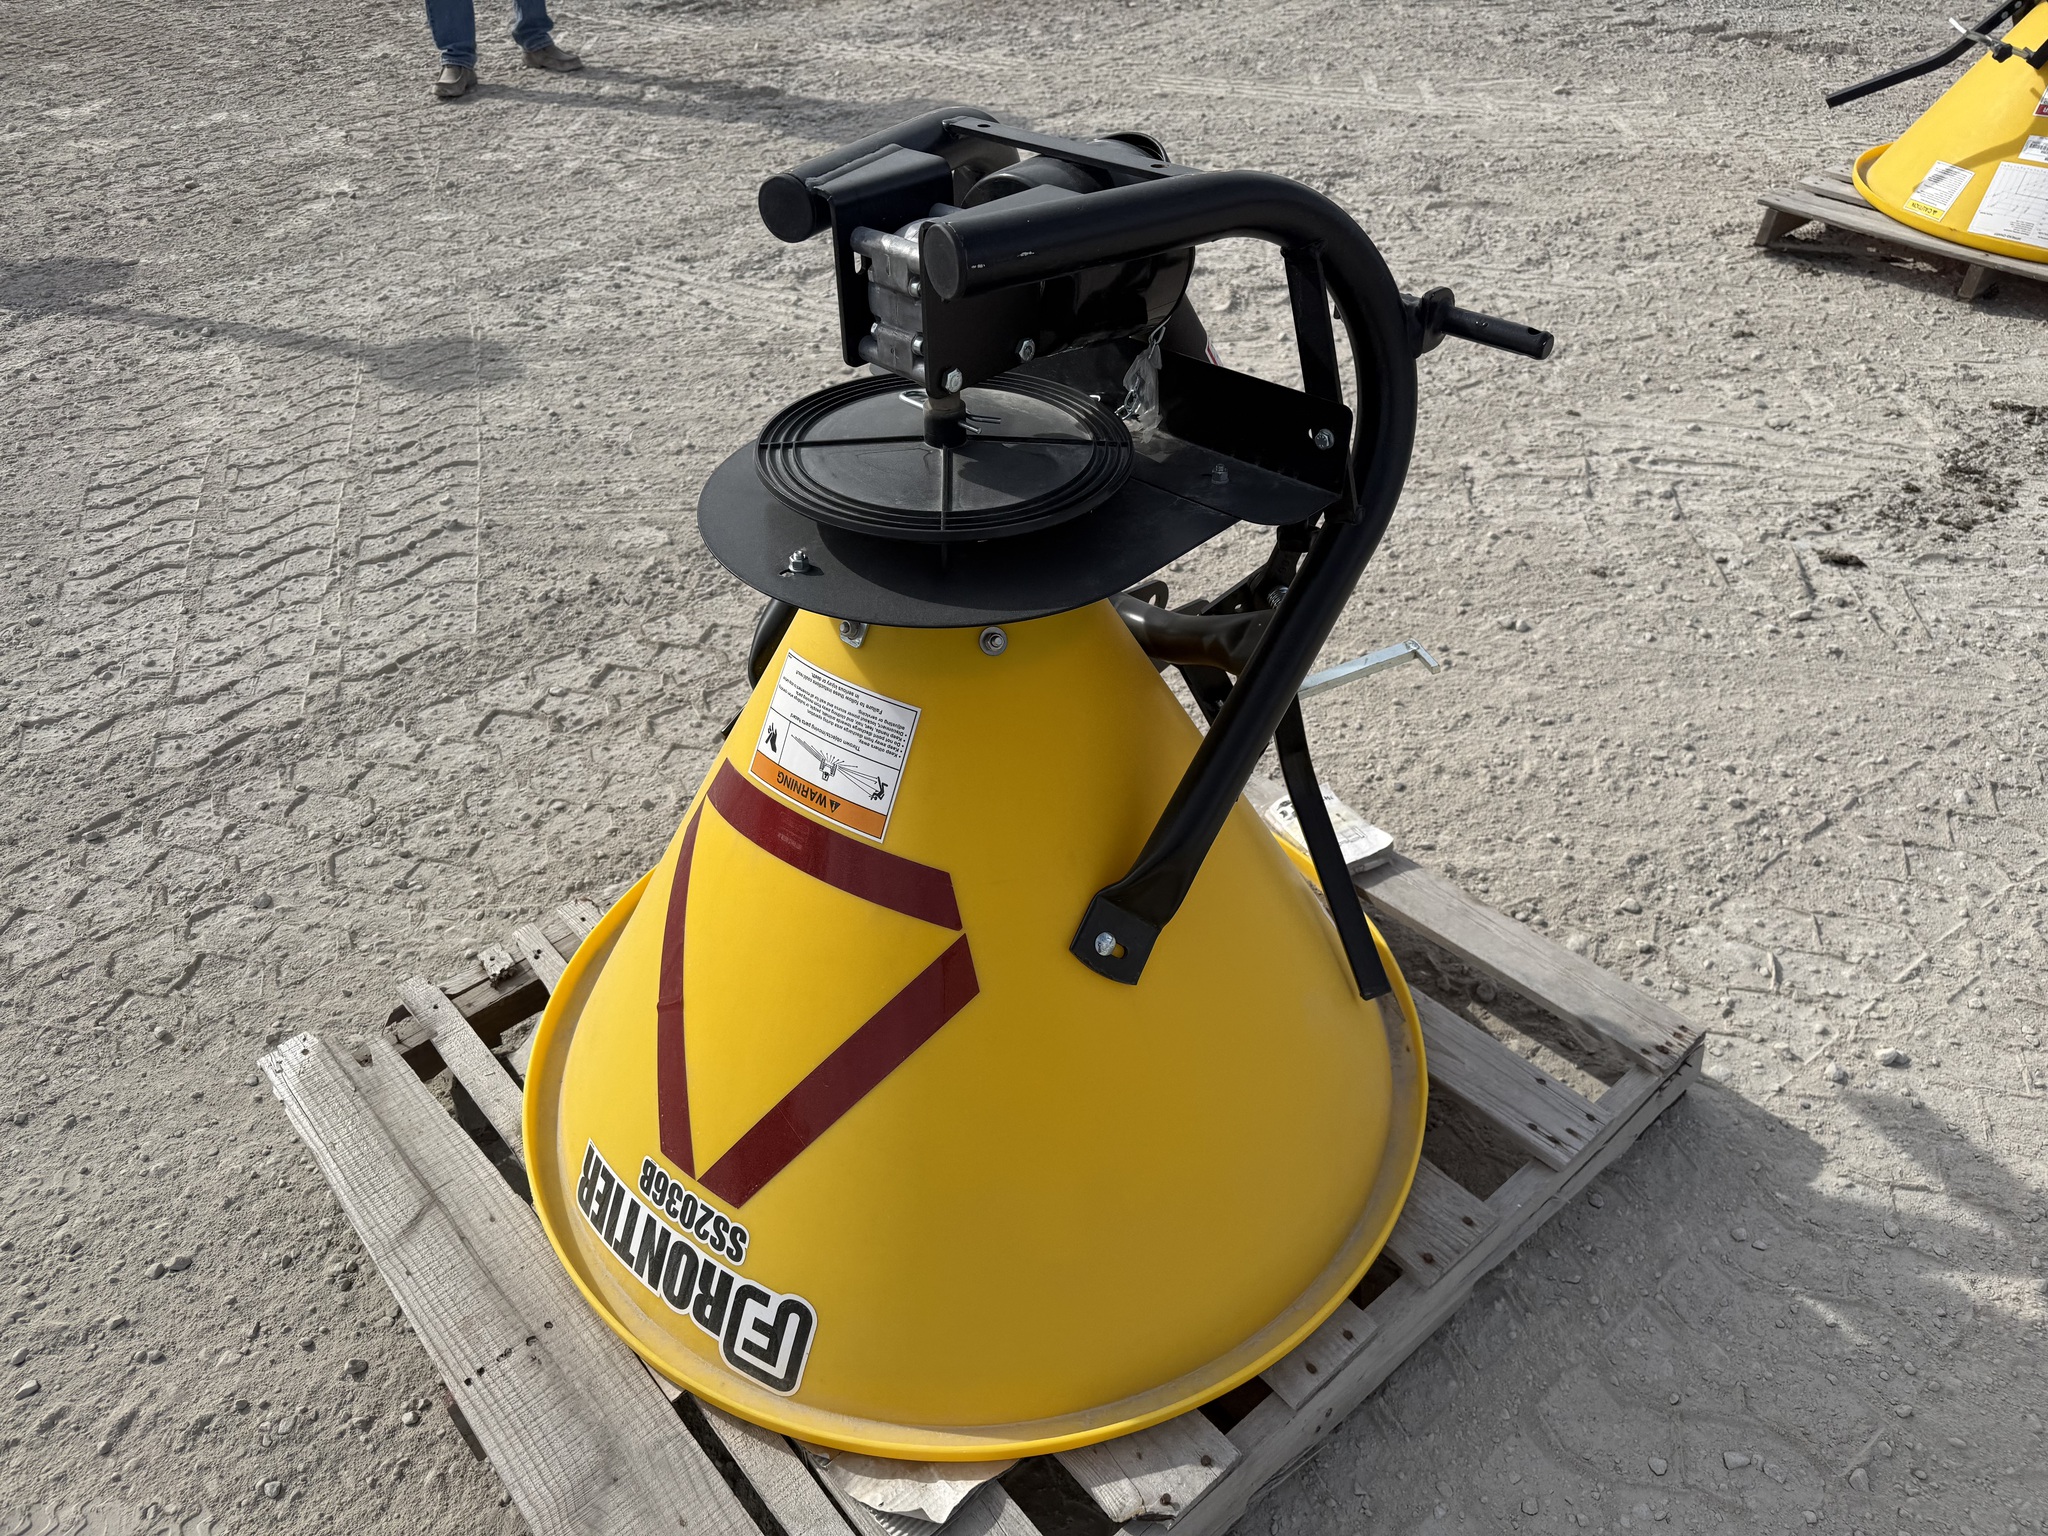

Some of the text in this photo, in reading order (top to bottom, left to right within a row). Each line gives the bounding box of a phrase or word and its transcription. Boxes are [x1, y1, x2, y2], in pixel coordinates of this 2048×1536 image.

[1911, 202, 1932, 214] CAUTION
[776, 771, 827, 808] WARNING
[640, 1160, 747, 1262] SS2036B
[577, 1147, 812, 1392] FRONTIER
